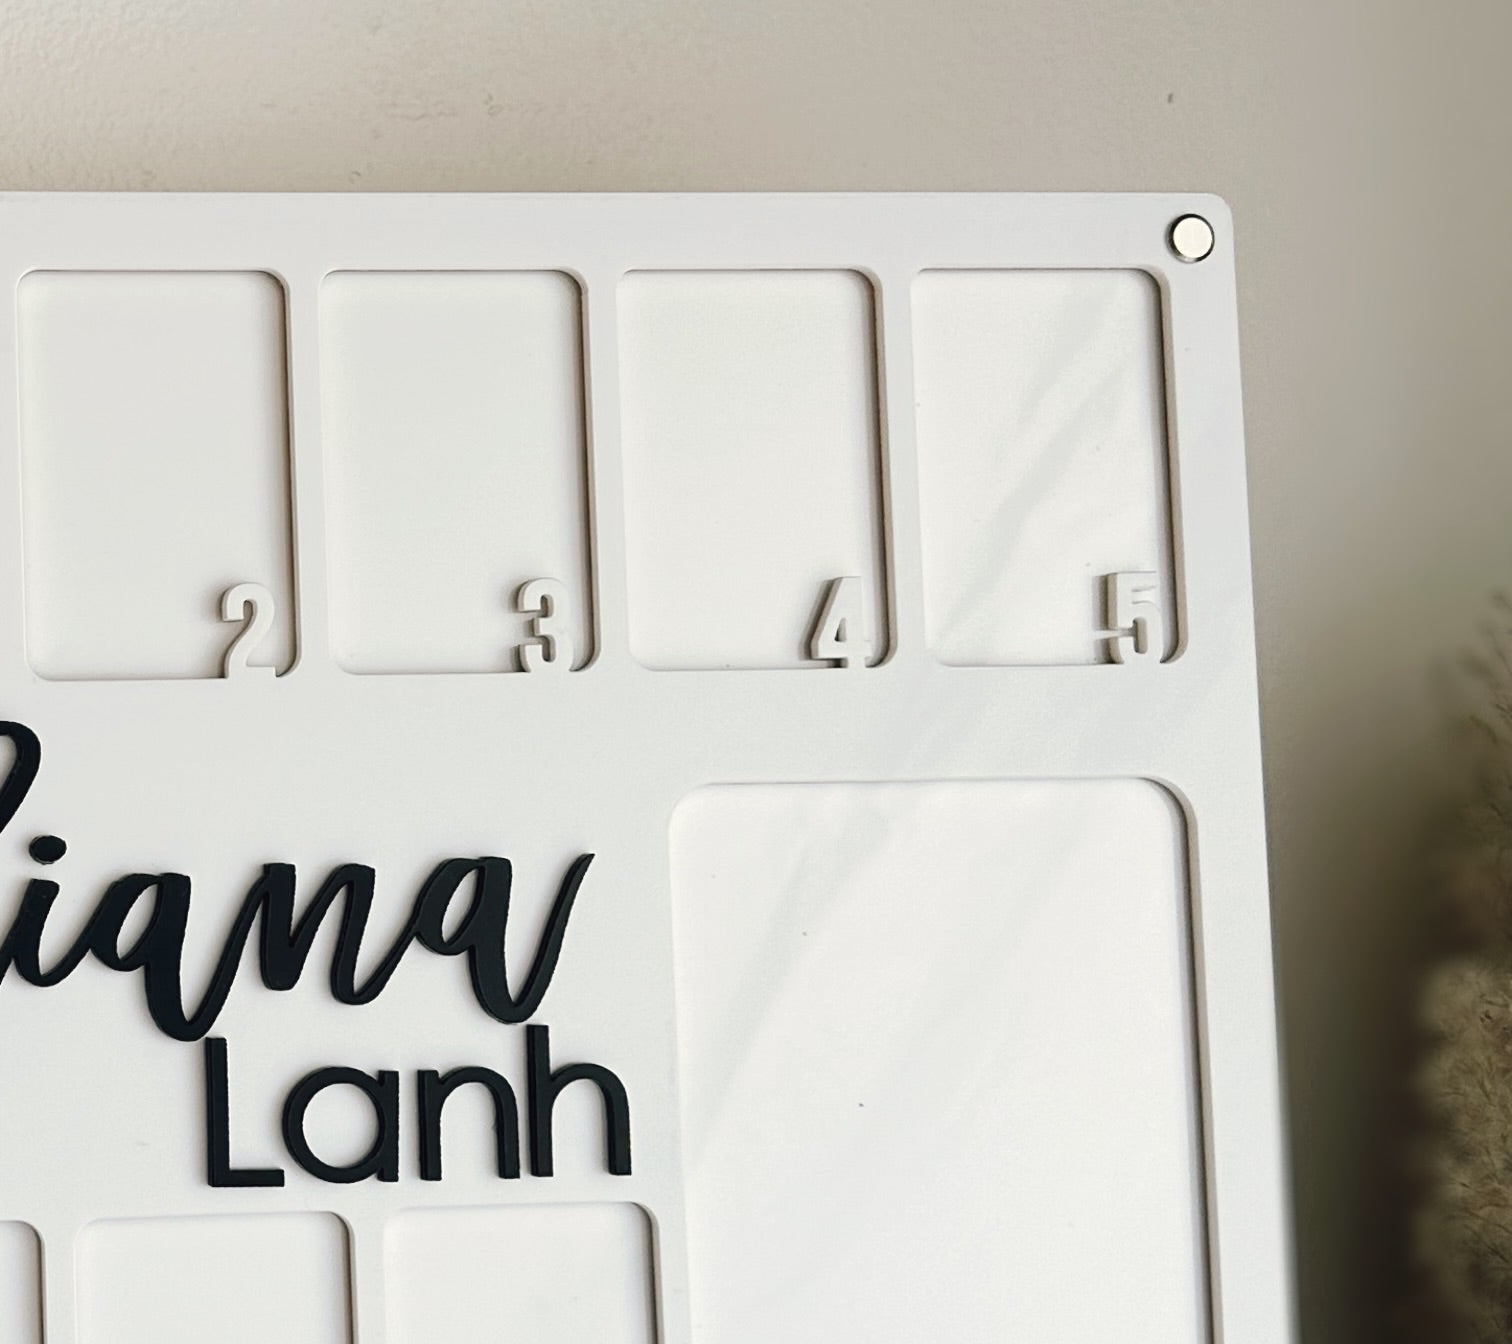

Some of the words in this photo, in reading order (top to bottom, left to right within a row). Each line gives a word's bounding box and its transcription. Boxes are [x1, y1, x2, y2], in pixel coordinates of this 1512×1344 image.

[221, 582, 277, 679] 2
[516, 576, 572, 673] 3
[808, 575, 867, 668] 4
[1100, 570, 1164, 665] 5
[205, 1023, 633, 1189] Lanh
